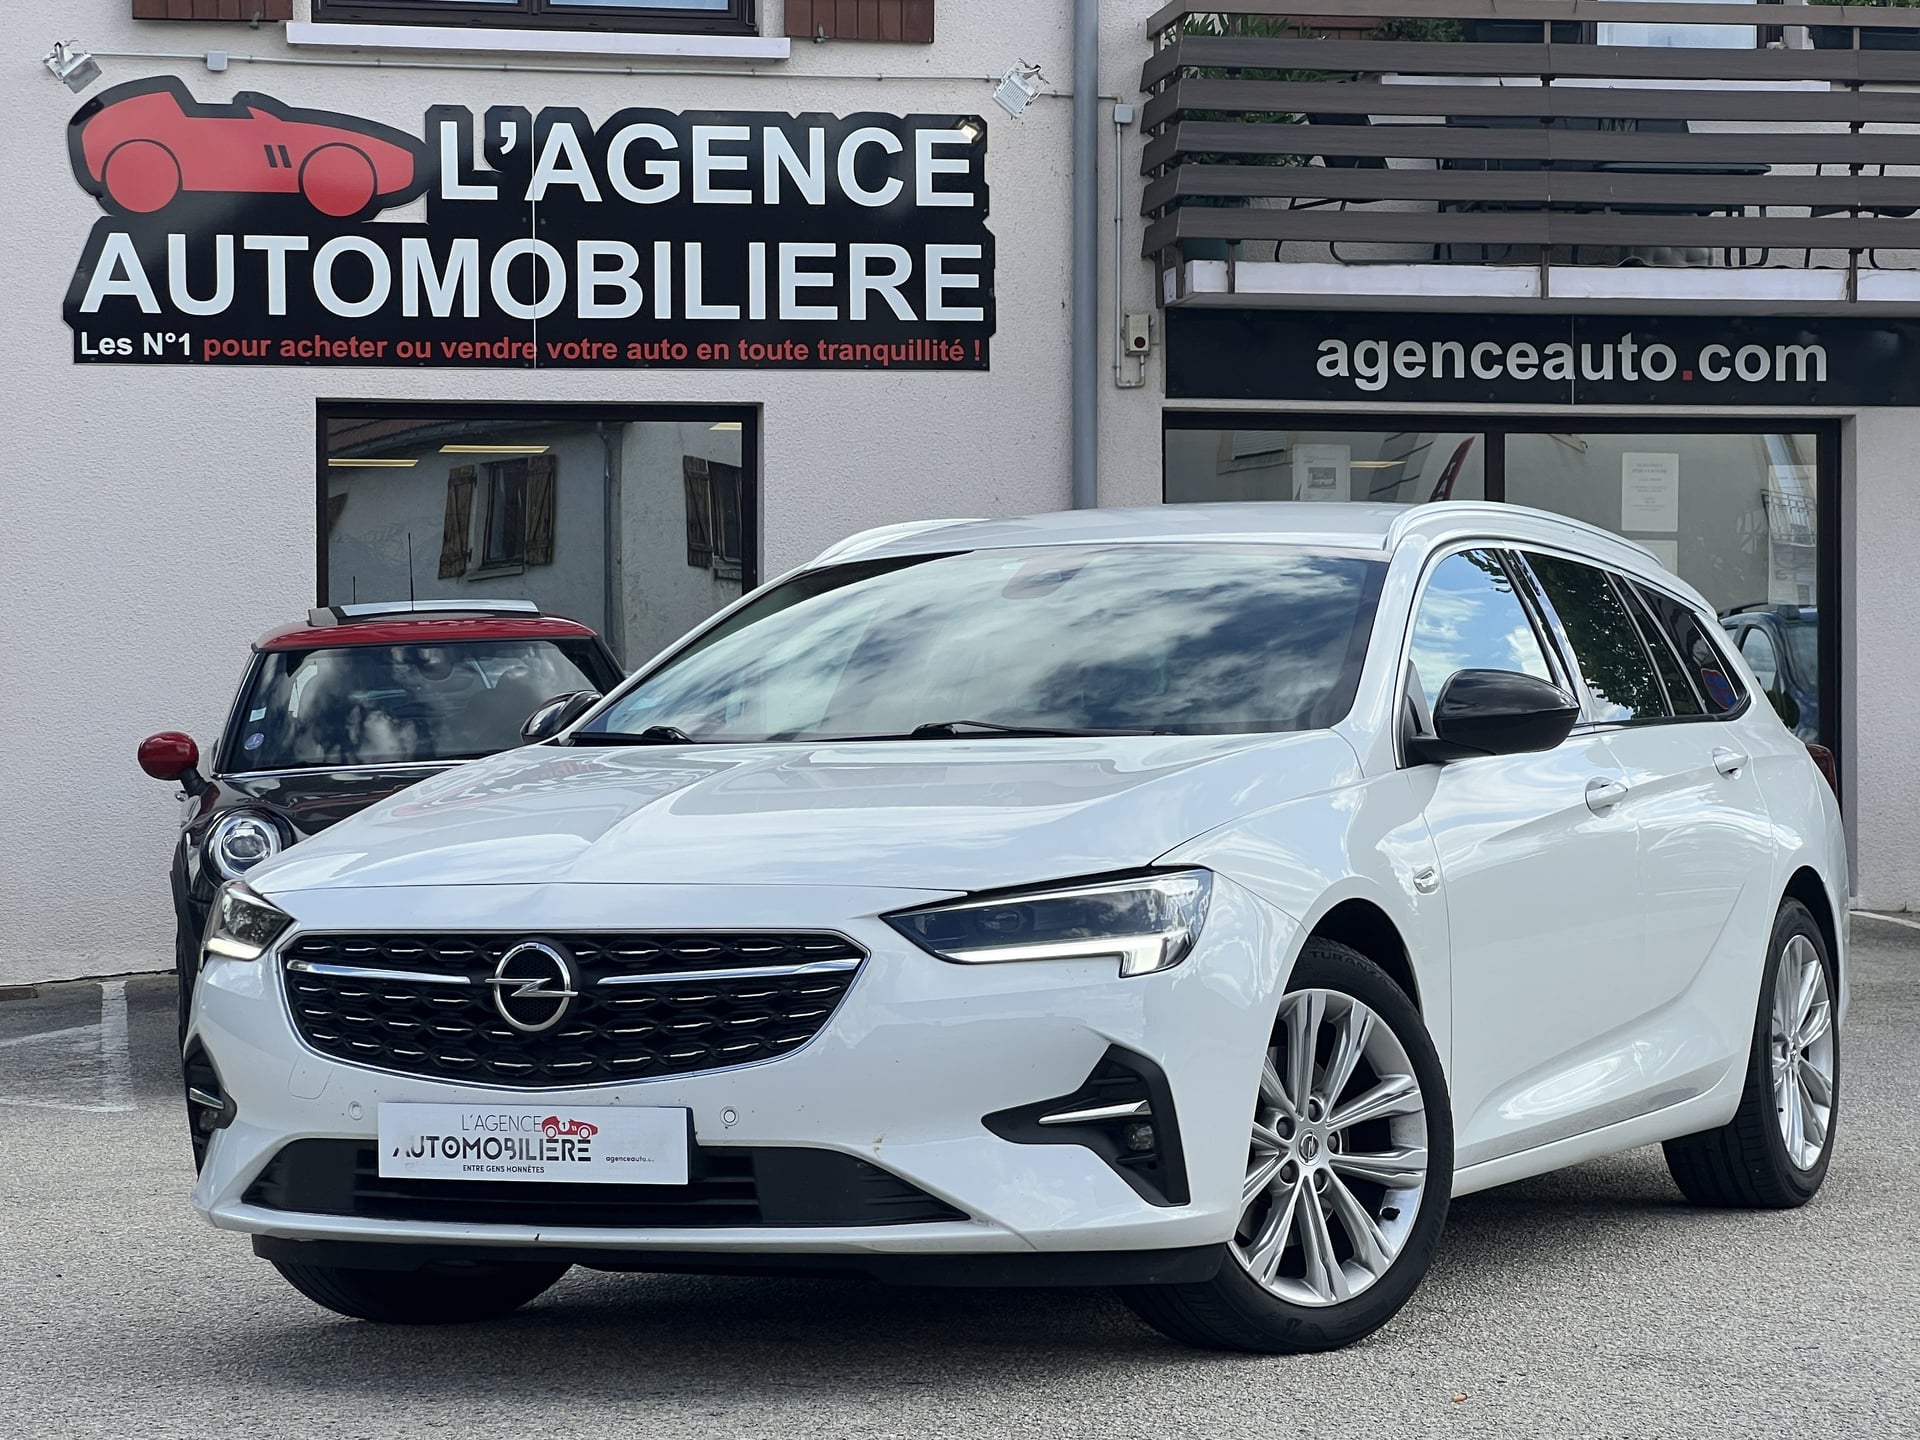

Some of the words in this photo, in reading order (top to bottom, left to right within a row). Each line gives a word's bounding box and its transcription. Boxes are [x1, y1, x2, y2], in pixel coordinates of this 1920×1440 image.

[439, 120, 975, 207] L'AGENCE
[79, 232, 984, 322] AUTOMOBILIERE
[81, 331, 133, 356] Les
[143, 332, 190, 356] N°1
[203, 336, 272, 361] pour
[280, 335, 388, 358] acheter
[396, 341, 432, 359] ou
[440, 337, 537, 360] vendre
[546, 338, 618, 360] votre
[626, 340, 688, 360] auto
[696, 344, 730, 361] en
[738, 341, 809, 361] toute
[817, 340, 964, 366] tranquillité
[974, 341, 981, 361] !
[1315, 331, 1828, 391] agenceauto.com
[461, 1113, 542, 1133] L'AGENCE
[462, 1164, 484, 1173] ENTRE
[485, 1165, 505, 1174] GENS
[506, 1164, 545, 1174] HONNÊTES
